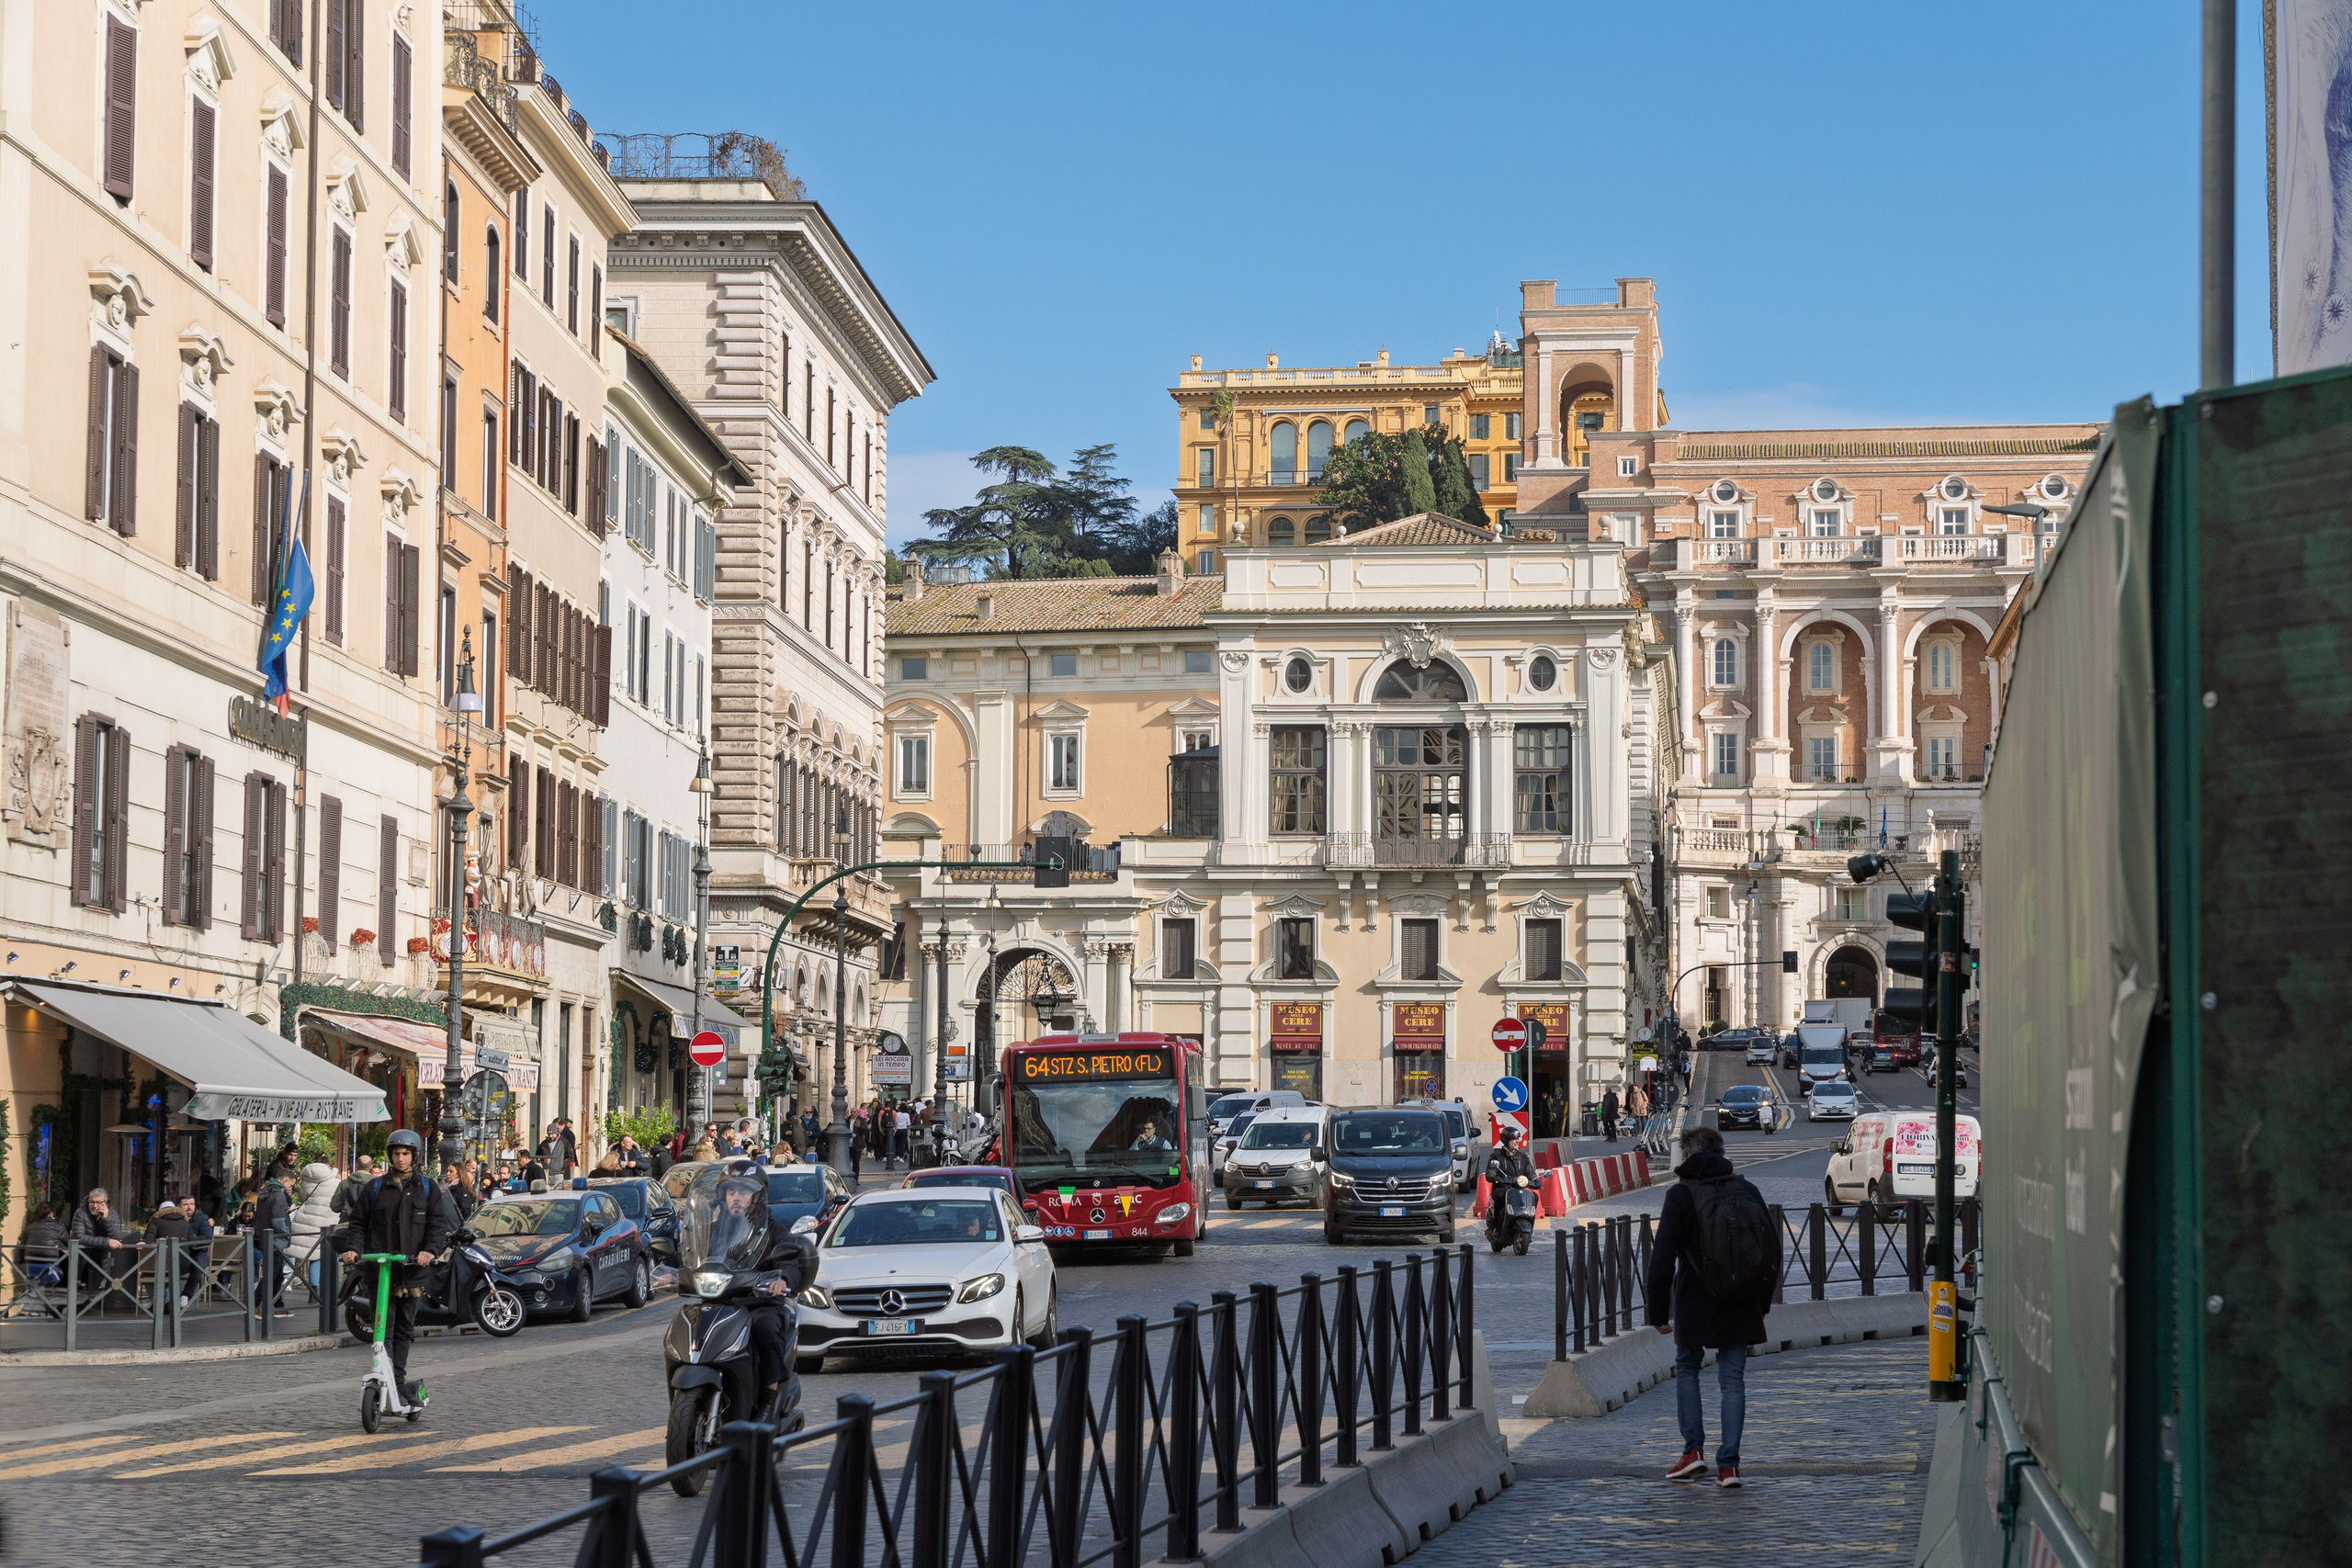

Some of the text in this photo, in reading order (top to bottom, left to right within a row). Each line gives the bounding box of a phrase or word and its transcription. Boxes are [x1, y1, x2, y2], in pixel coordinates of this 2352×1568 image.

[1277, 1006, 1317, 1014] MUSEO
[1399, 1007, 1439, 1015] MUSEO
[1524, 1007, 1564, 1015] MUSEO
[1282, 1018, 1312, 1026] CERE
[1404, 1018, 1435, 1026] CERE
[1025, 1055, 1161, 1077] 64 STZ S. PIETRO (FL)
[229, 1098, 353, 1120] GELATERIA WINE BAR RISTORANTE
[1048, 1197, 1082, 1207] ROA
[1131, 1227, 1148, 1236] 844
[598, 1247, 630, 1270] CARABINIERI
